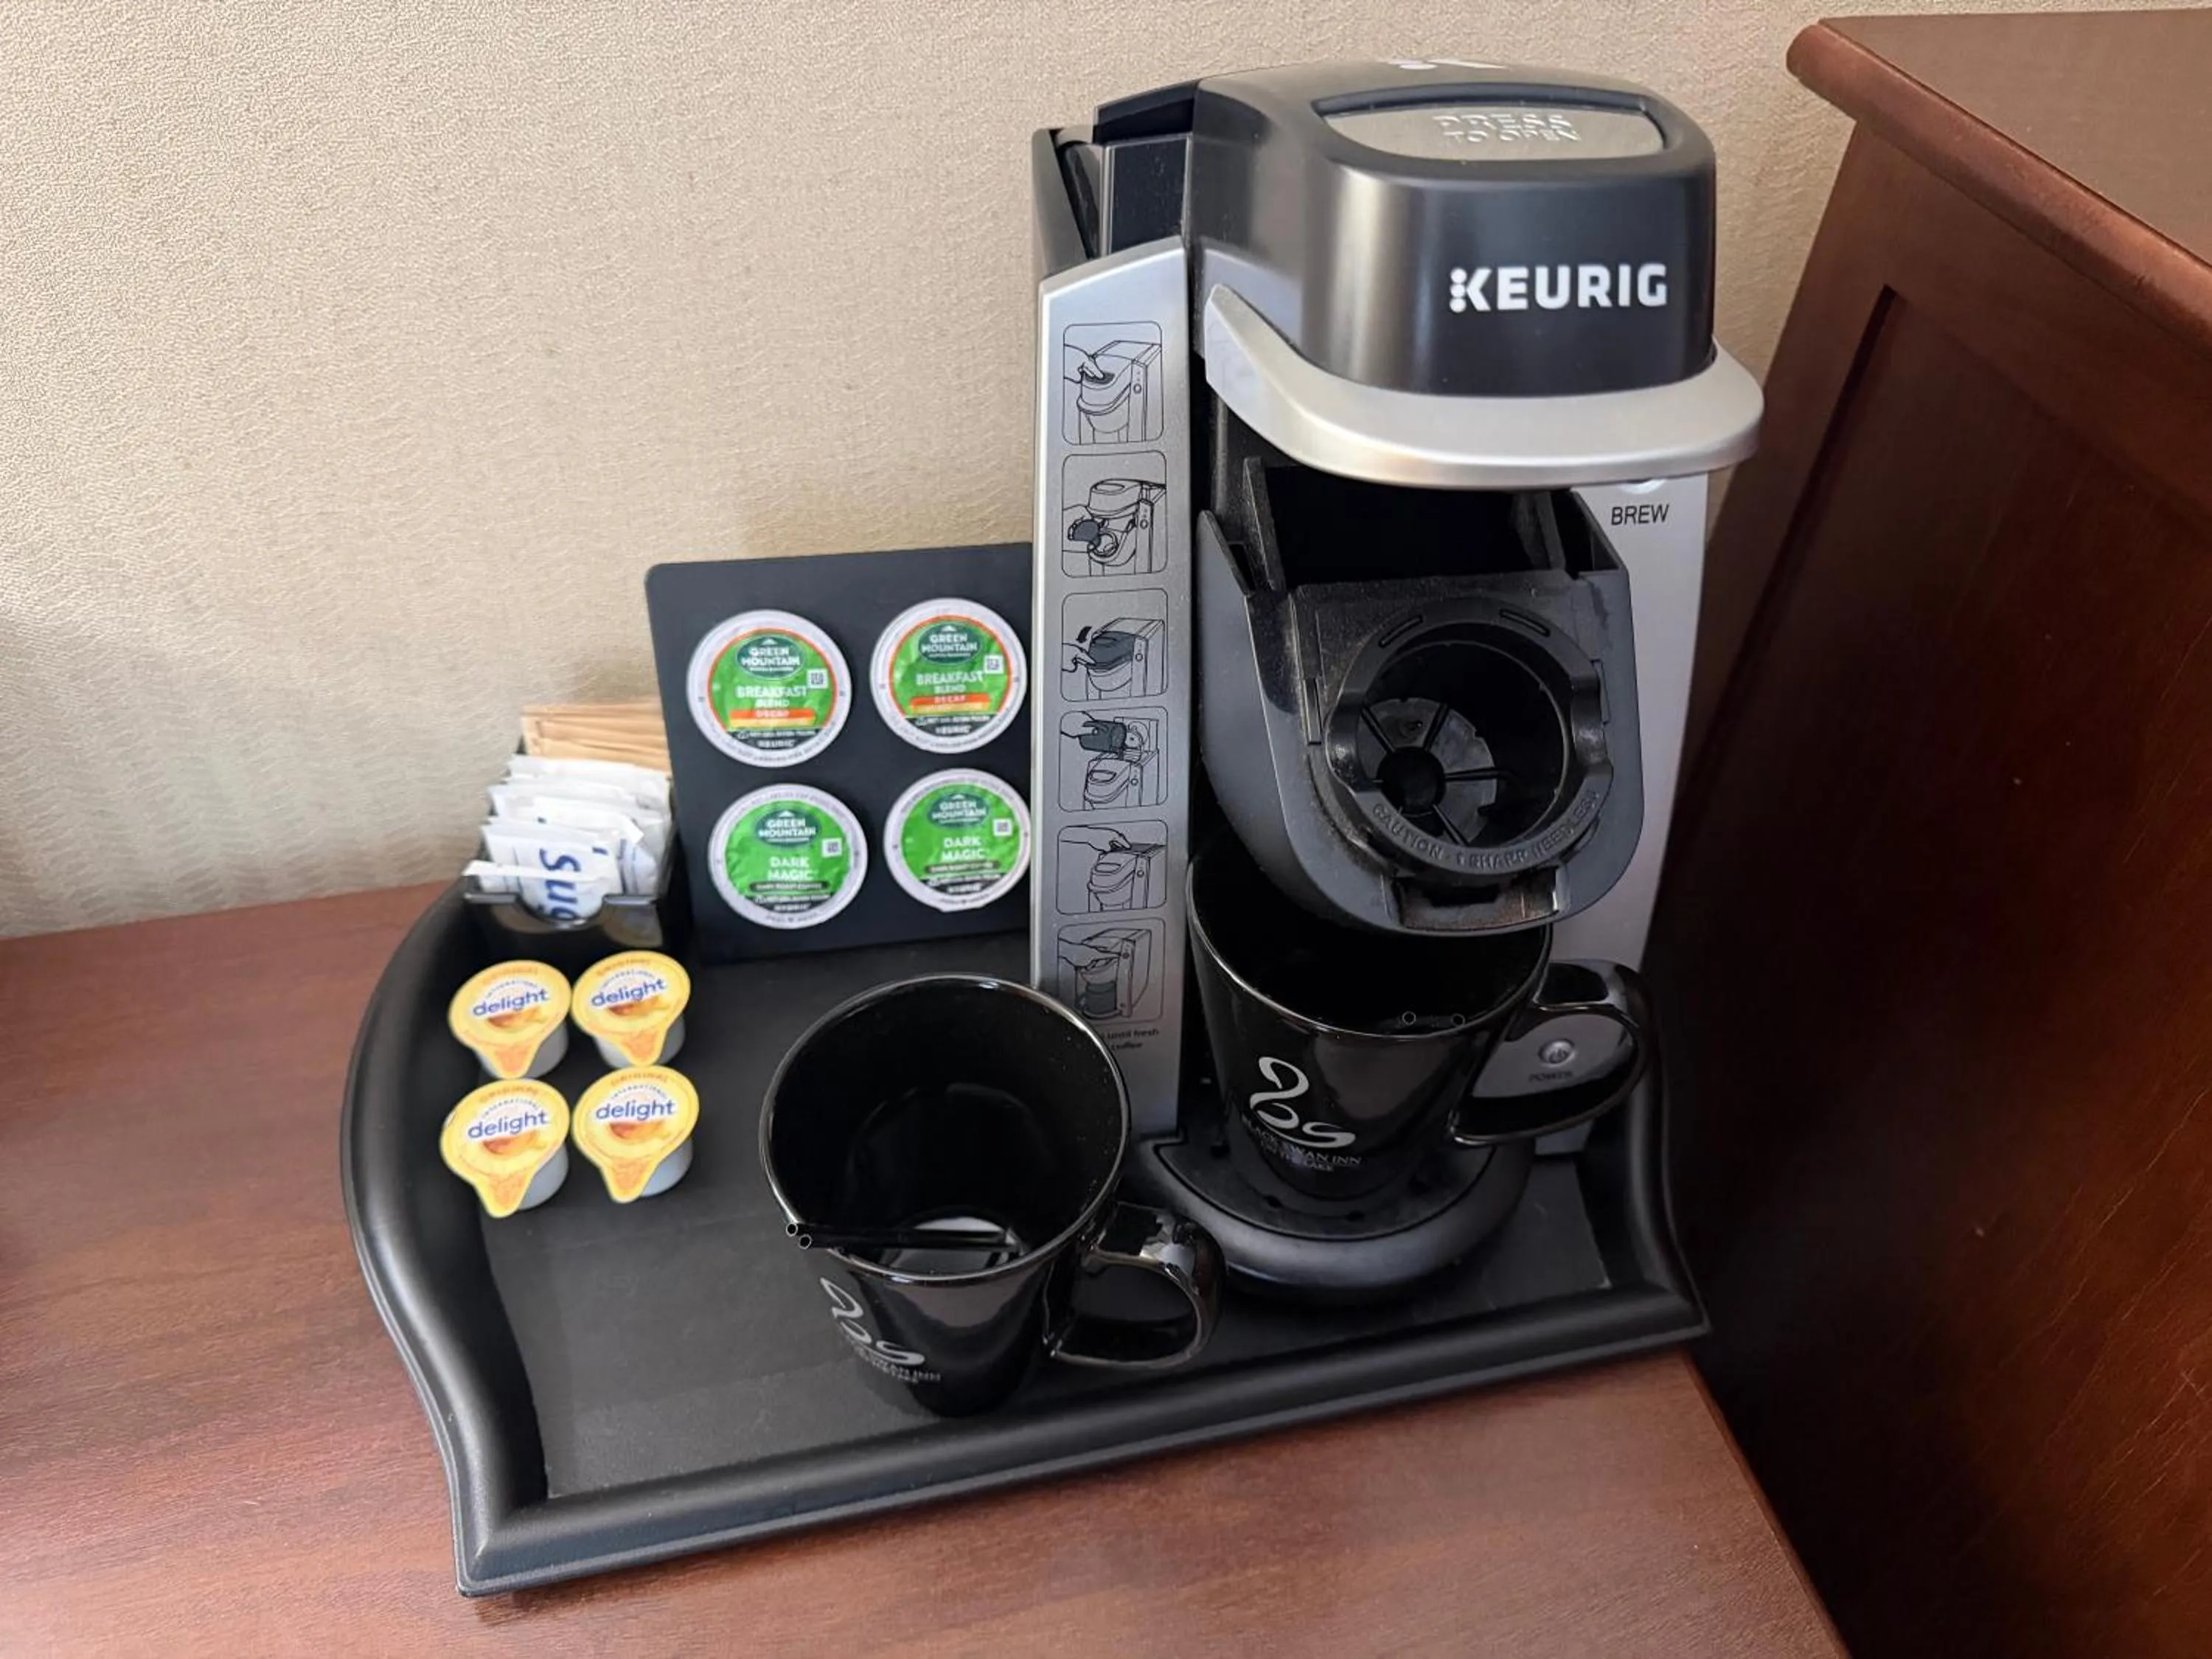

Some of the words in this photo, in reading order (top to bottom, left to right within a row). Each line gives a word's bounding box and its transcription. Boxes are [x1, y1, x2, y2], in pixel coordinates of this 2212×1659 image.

[1432, 114, 1572, 131] PRESS
[1442, 130, 1489, 143] TO
[1498, 128, 1582, 142] OPEN
[1450, 263, 1667, 313] KEURIG
[1611, 504, 1669, 525] BREW
[929, 633, 968, 644] GREEN
[922, 641, 978, 653] MOUNTAIN
[741, 655, 801, 667] MOUNTAIN
[916, 671, 984, 686] BREAKFAST
[736, 685, 807, 698] BREAKFAST
[1374, 803, 1444, 860] CAUTION
[943, 837, 981, 848] DARK
[770, 856, 810, 868] DARK
[941, 848, 986, 861] MAGIC
[768, 869, 815, 881] MAGIC
[591, 978, 667, 1007] delight
[472, 987, 550, 1018] delight
[595, 1099, 676, 1121] delight
[467, 1110, 549, 1140] delight
